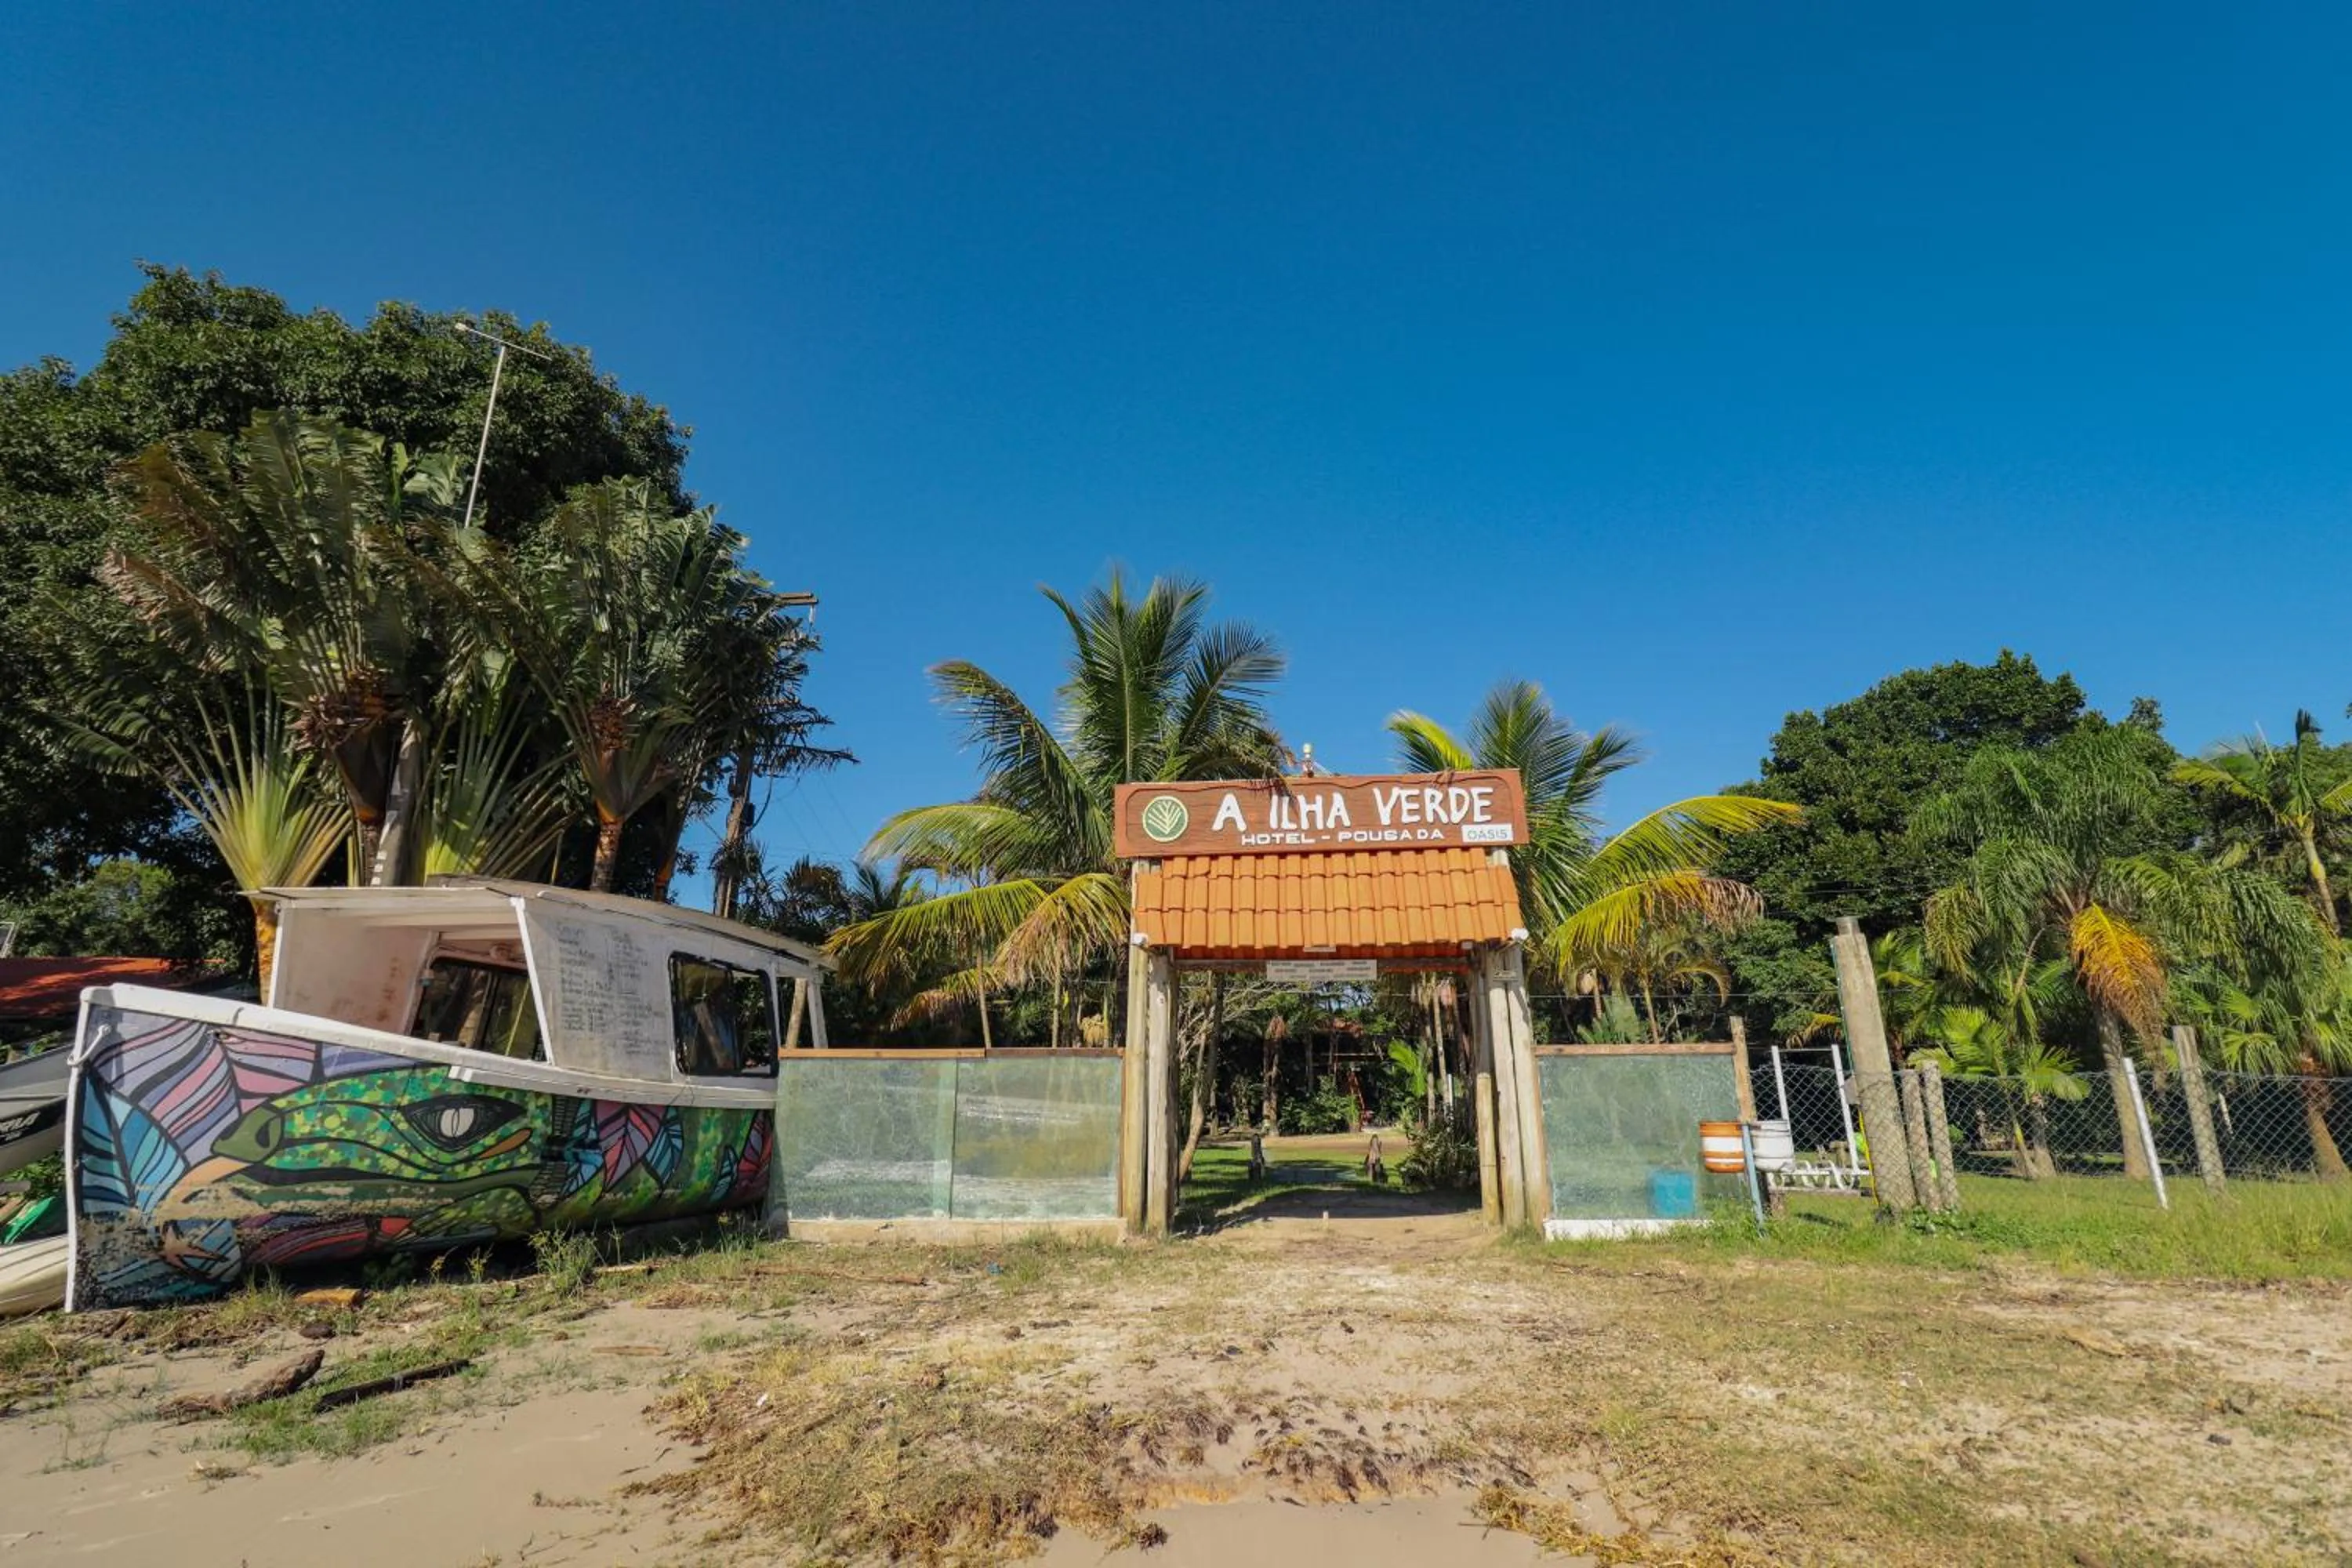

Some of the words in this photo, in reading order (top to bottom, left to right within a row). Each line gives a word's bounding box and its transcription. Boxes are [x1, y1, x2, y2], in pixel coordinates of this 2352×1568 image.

[1211, 792, 1247, 832] A
[1269, 791, 1351, 830] ILHA
[1373, 786, 1494, 825] VERDE
[1241, 832, 1316, 846] HOTEL
[1338, 829, 1445, 843] POUSADA
[1467, 828, 1508, 840] OASIS
